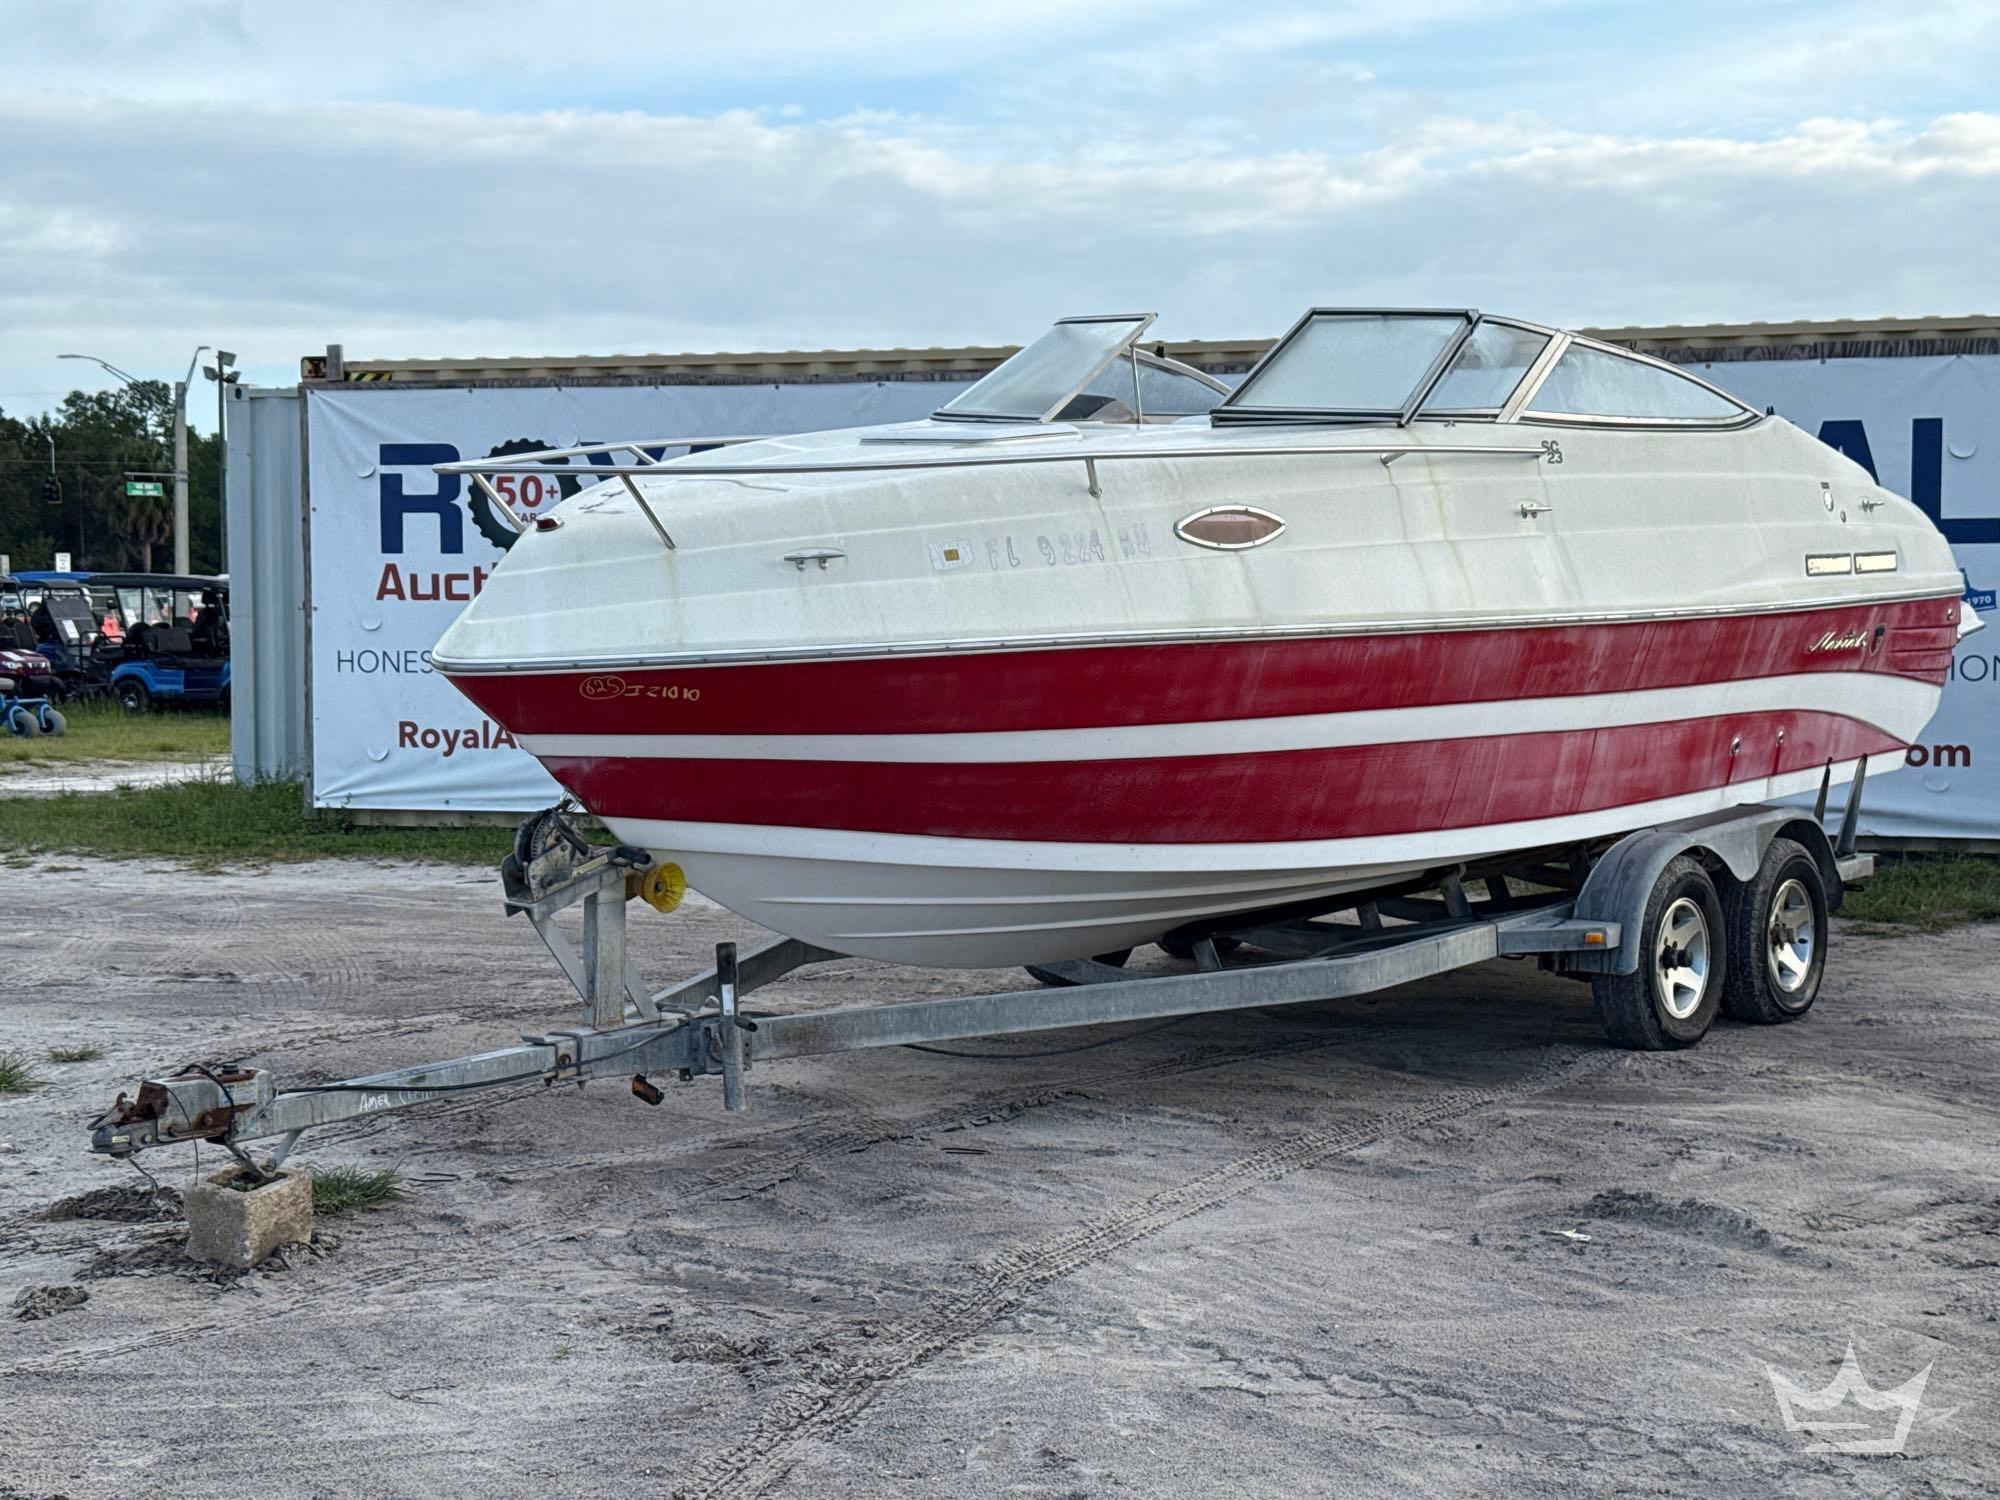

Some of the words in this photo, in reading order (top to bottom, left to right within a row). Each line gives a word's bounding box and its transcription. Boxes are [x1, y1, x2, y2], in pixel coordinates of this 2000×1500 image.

[1541, 440, 1559, 453] SC
[1547, 450, 1563, 464] 23
[496, 475, 559, 508] 50+
